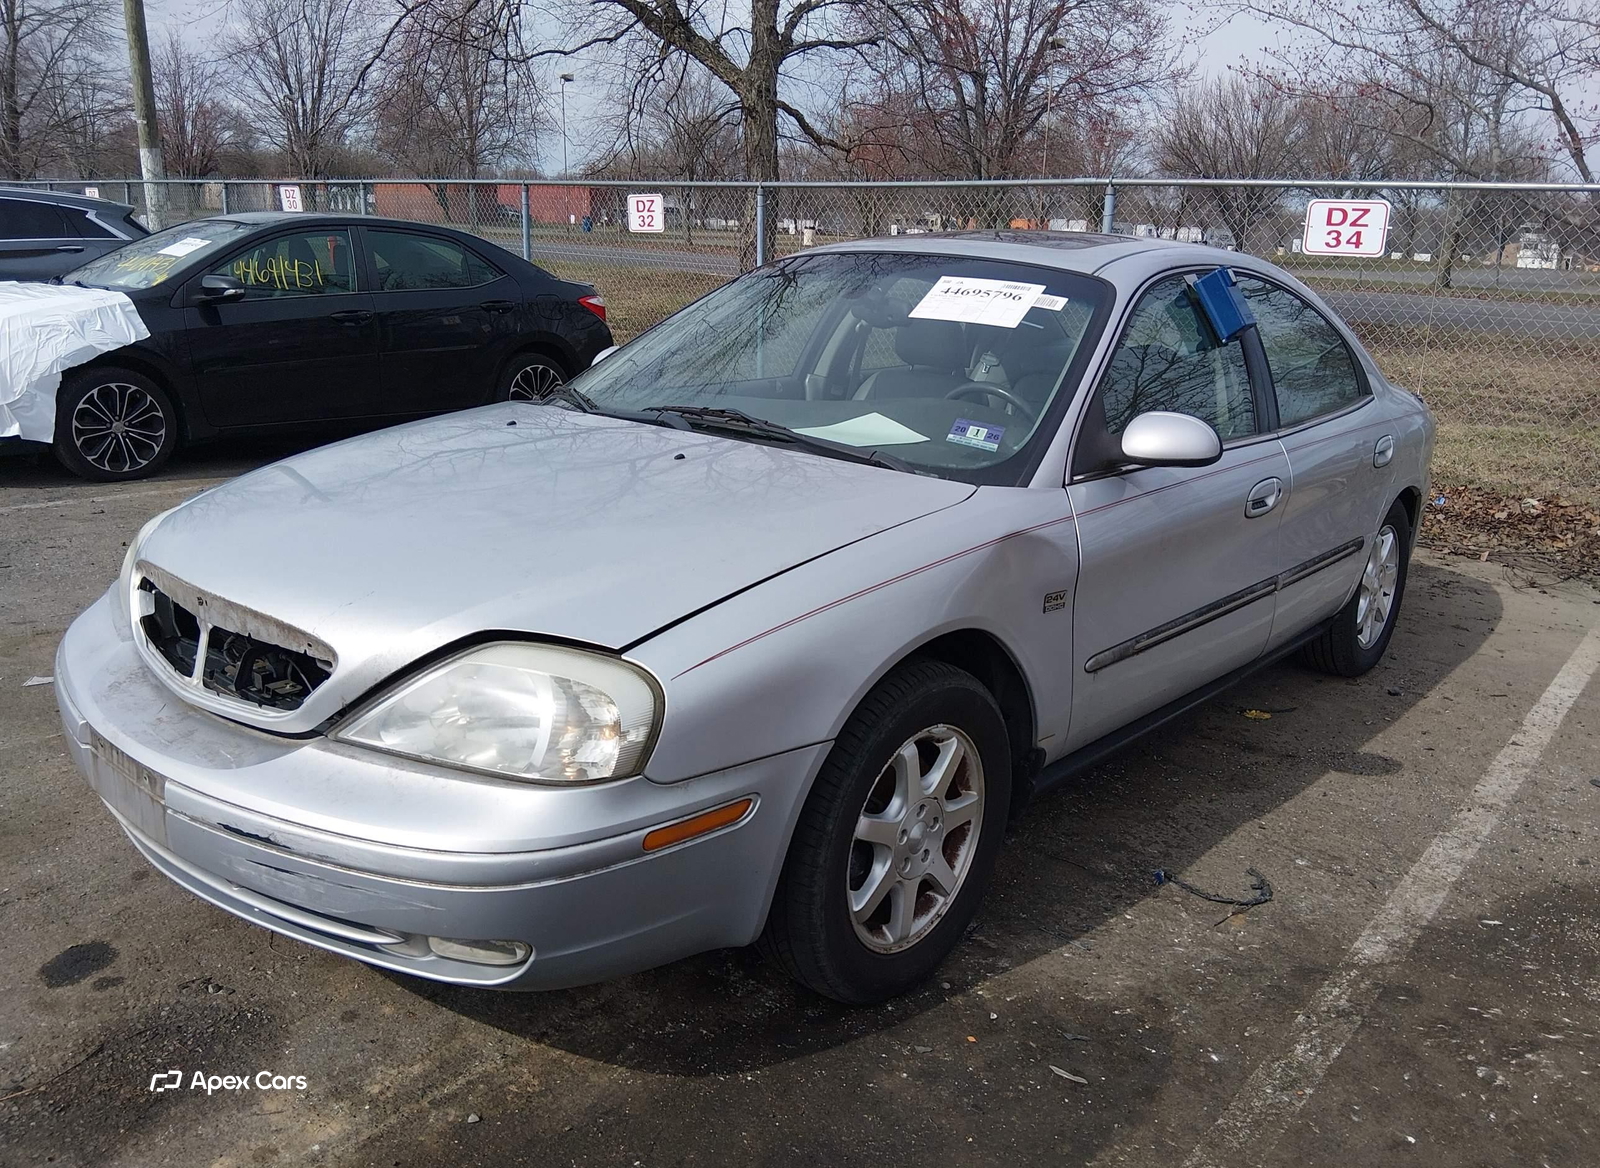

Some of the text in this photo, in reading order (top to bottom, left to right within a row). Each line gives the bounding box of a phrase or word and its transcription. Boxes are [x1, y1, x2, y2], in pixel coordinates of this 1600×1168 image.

[284, 189, 296, 199] DZ
[287, 200, 298, 209] 30
[636, 200, 655, 213] DZ
[638, 215, 654, 227] 32
[1326, 207, 1371, 227] DZ
[1325, 230, 1363, 248] 34
[233, 255, 323, 290] 44691431
[940, 286, 1023, 301] 44695796
[954, 425, 1000, 440] 20 1 26
[1046, 592, 1066, 604] 24V
